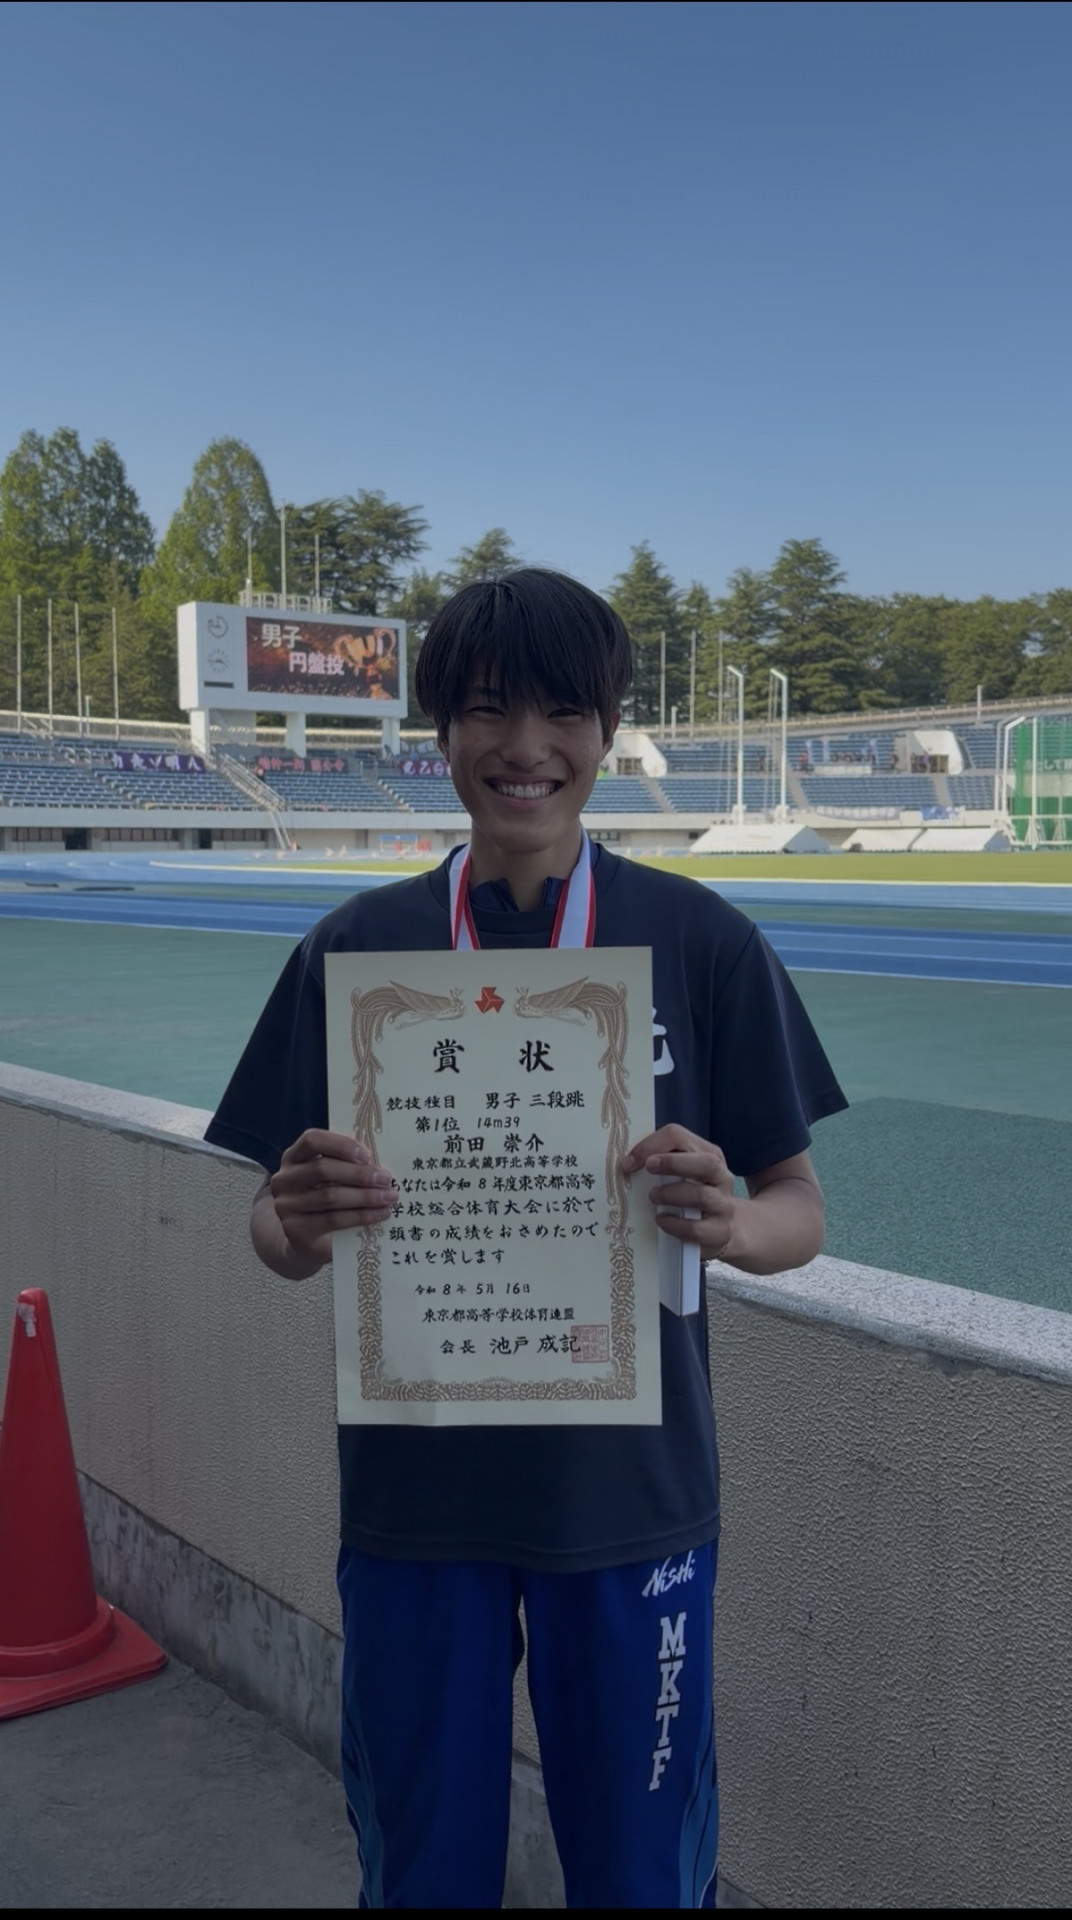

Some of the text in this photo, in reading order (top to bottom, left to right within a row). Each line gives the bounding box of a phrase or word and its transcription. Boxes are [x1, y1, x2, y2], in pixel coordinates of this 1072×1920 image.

[261, 622, 302, 649] 男子
[288, 651, 345, 676] 円盤投
[432, 1038, 555, 1074] 賞 状
[386, 1089, 585, 1112] 競技種目 男子 三段跳
[415, 1116, 521, 1136] 第1位 14m39
[443, 1133, 485, 1154] 前田
[412, 1154, 578, 1171] 東京都立武蔵野北高等学校
[391, 1247, 505, 1265] これを賞します
[421, 1307, 575, 1324] 東京都高等学校体育連盟
[439, 1338, 477, 1355] 会長
[489, 1335, 529, 1356] 池戸
[536, 1334, 582, 1355] 成記
[649, 1611, 687, 1792] MKTF
